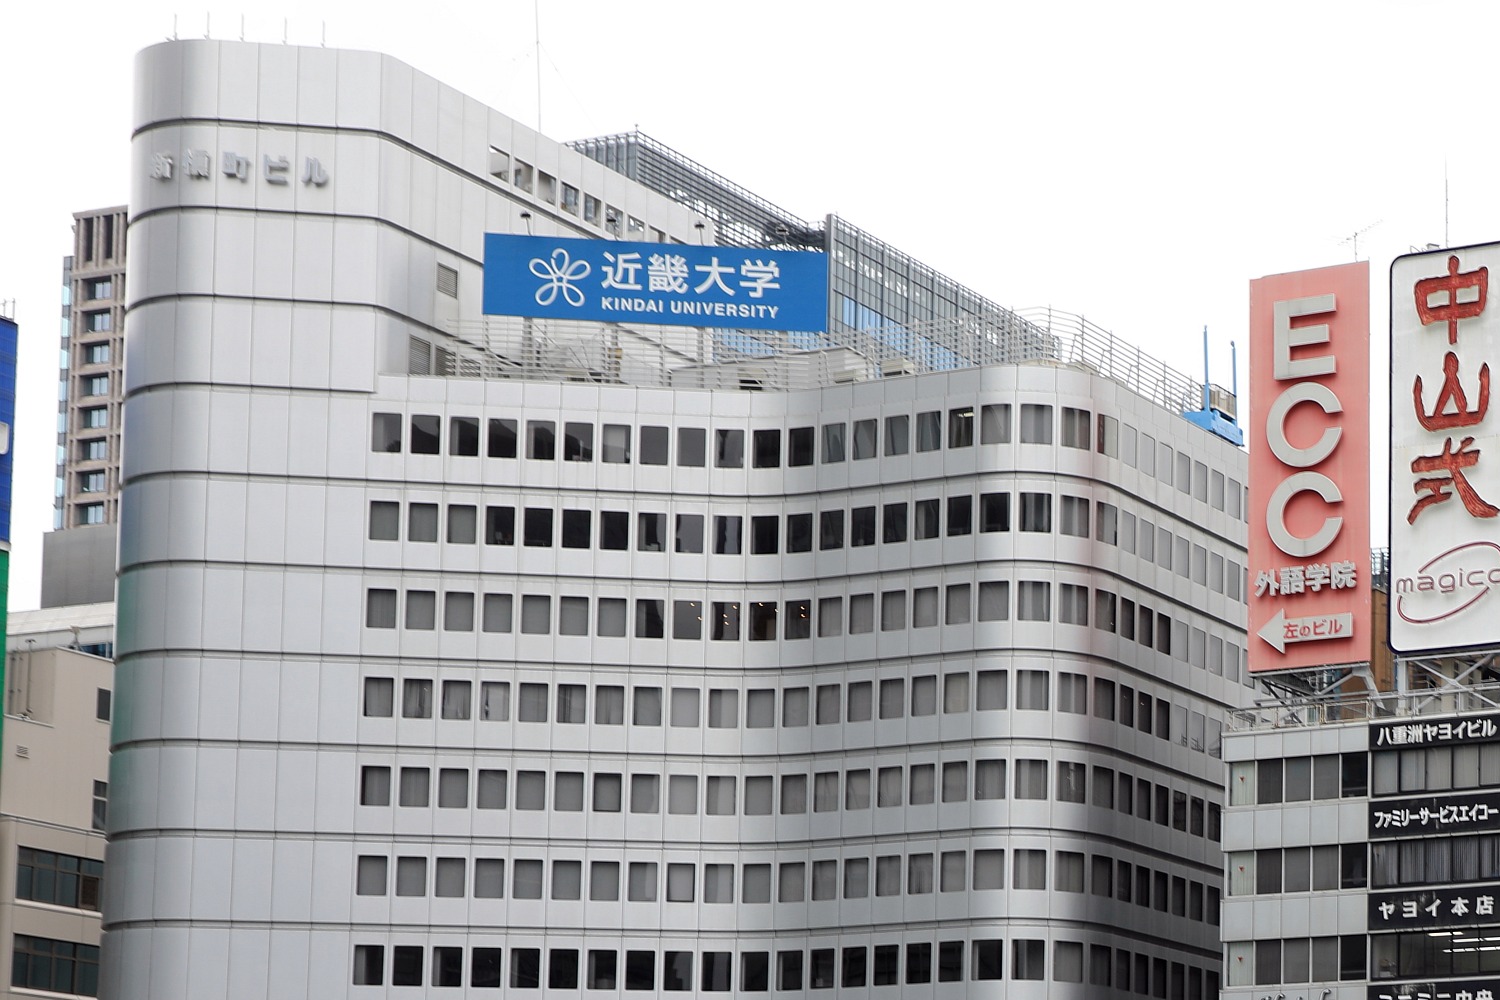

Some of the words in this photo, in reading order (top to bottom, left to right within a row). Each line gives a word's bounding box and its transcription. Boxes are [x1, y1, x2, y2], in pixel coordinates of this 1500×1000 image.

[601, 251, 781, 298] 近畿大学
[601, 296, 664, 313] KINDAI
[670, 301, 779, 319] UNIVERSITY
[1406, 255, 1500, 525] 中山式
[1266, 292, 1343, 558] ECC
[1254, 560, 1357, 597] 外語学院
[1282, 613, 1343, 641] 左のビル
[1377, 719, 1497, 746] 八重洲ヤヨイビル
[1374, 803, 1499, 829] ファミリーサービスエイコー
[1379, 895, 1495, 920] ヤヨイ本店
